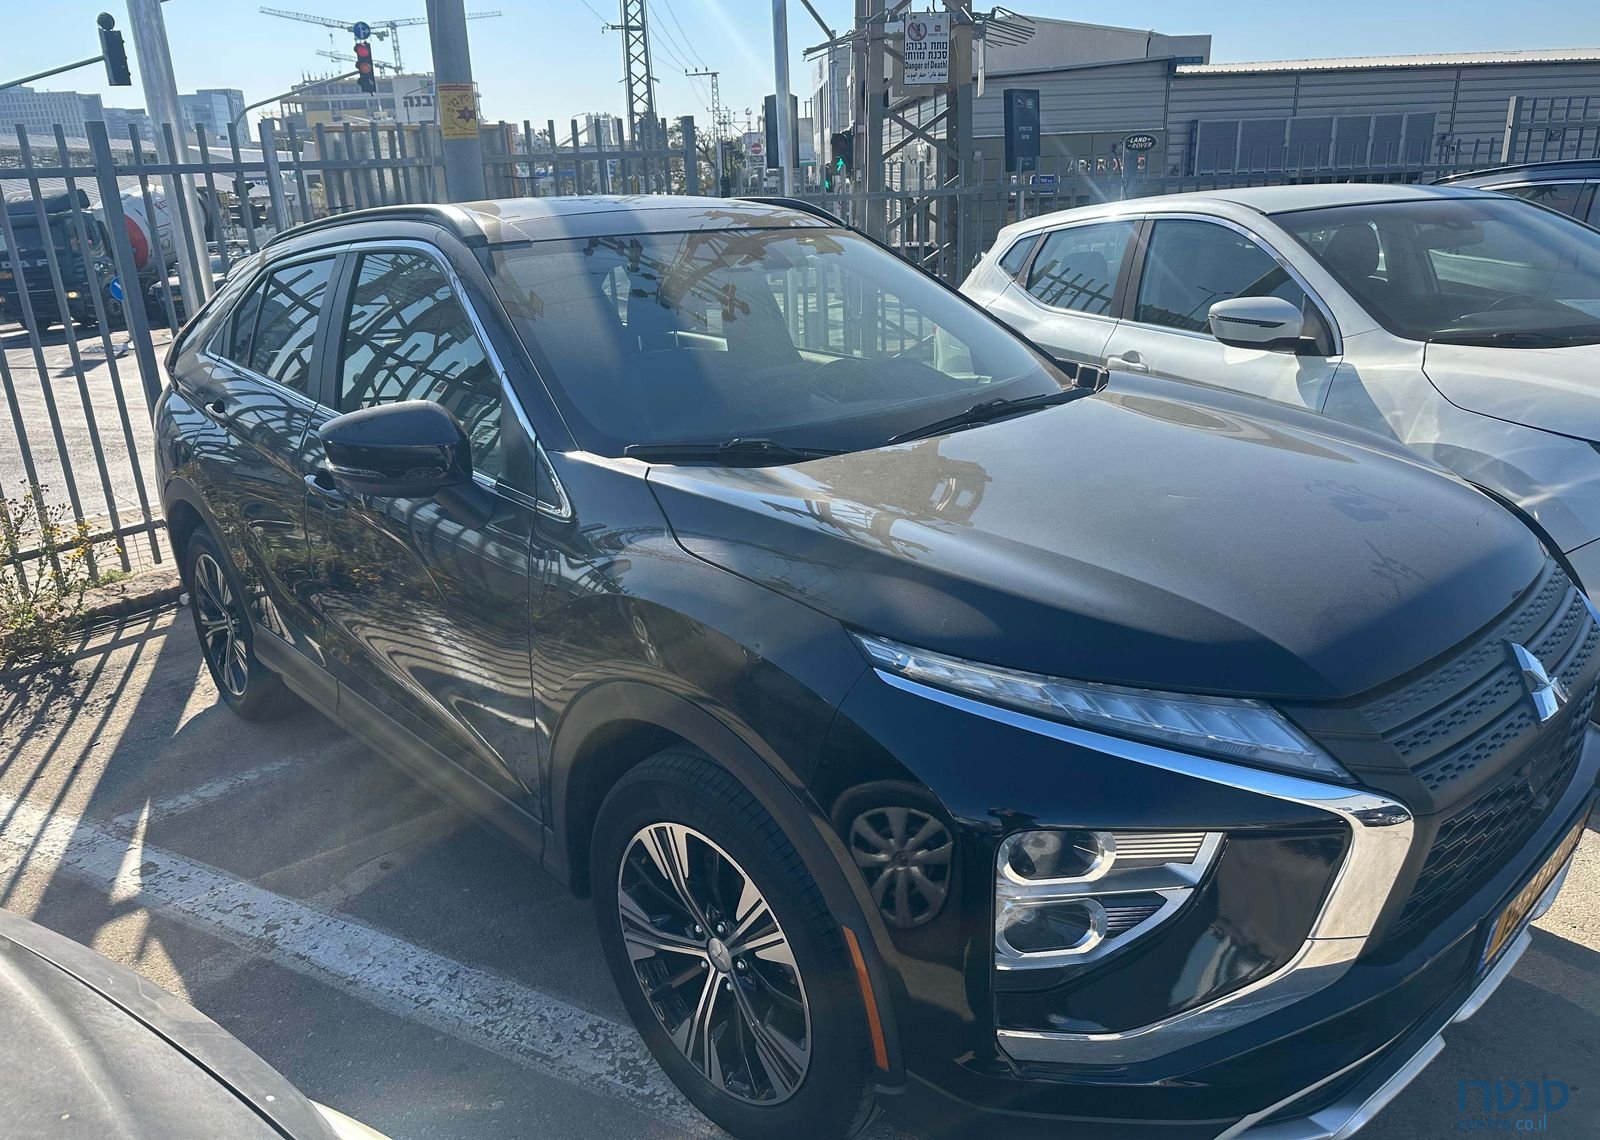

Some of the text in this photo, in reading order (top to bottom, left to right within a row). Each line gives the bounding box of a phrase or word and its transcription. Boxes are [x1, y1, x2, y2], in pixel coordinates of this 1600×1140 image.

[906, 42, 927, 50] גבוה!
[928, 51, 948, 59] סכנת
[905, 60, 947, 71] Danger of Death!
[402, 95, 435, 108] בנה
[1, 259, 48, 269] DAF
